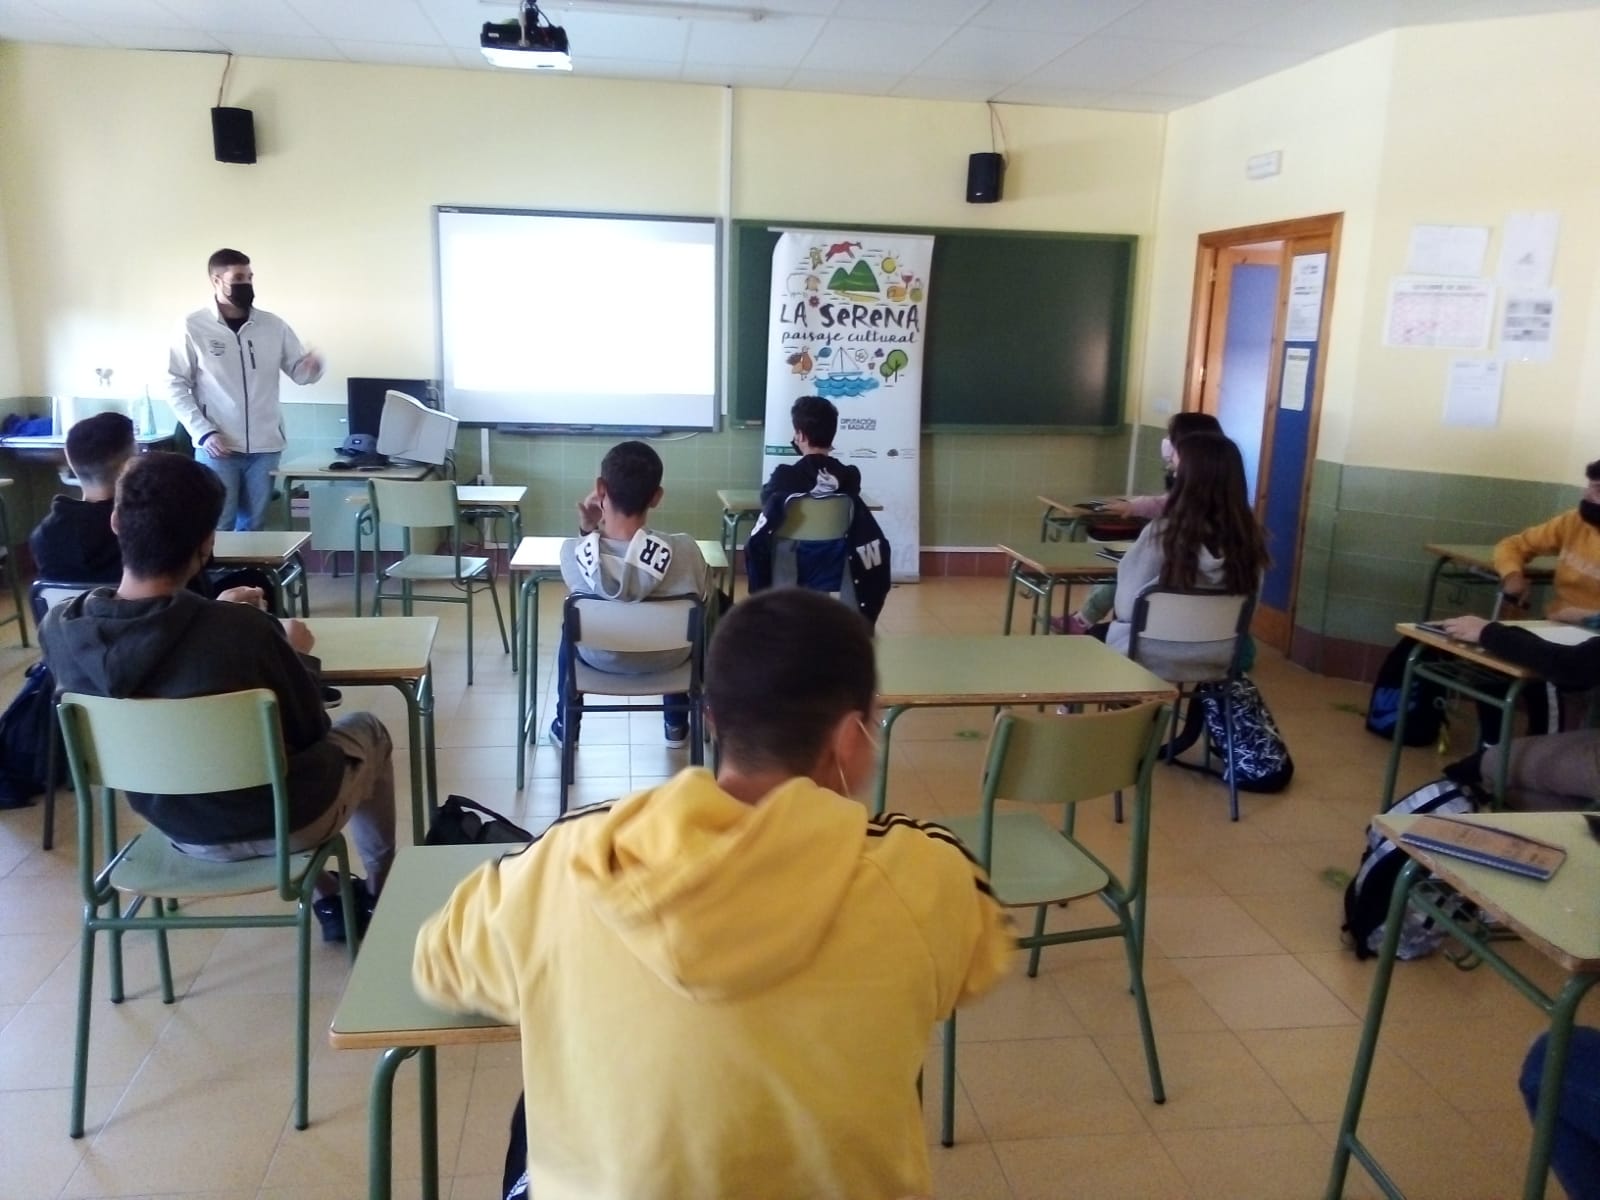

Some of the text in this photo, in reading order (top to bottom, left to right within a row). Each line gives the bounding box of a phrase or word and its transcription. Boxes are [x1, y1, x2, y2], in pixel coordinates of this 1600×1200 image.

[779, 301, 808, 328] LA
[782, 330, 916, 345] paisaje cultural
[856, 539, 882, 571] W
